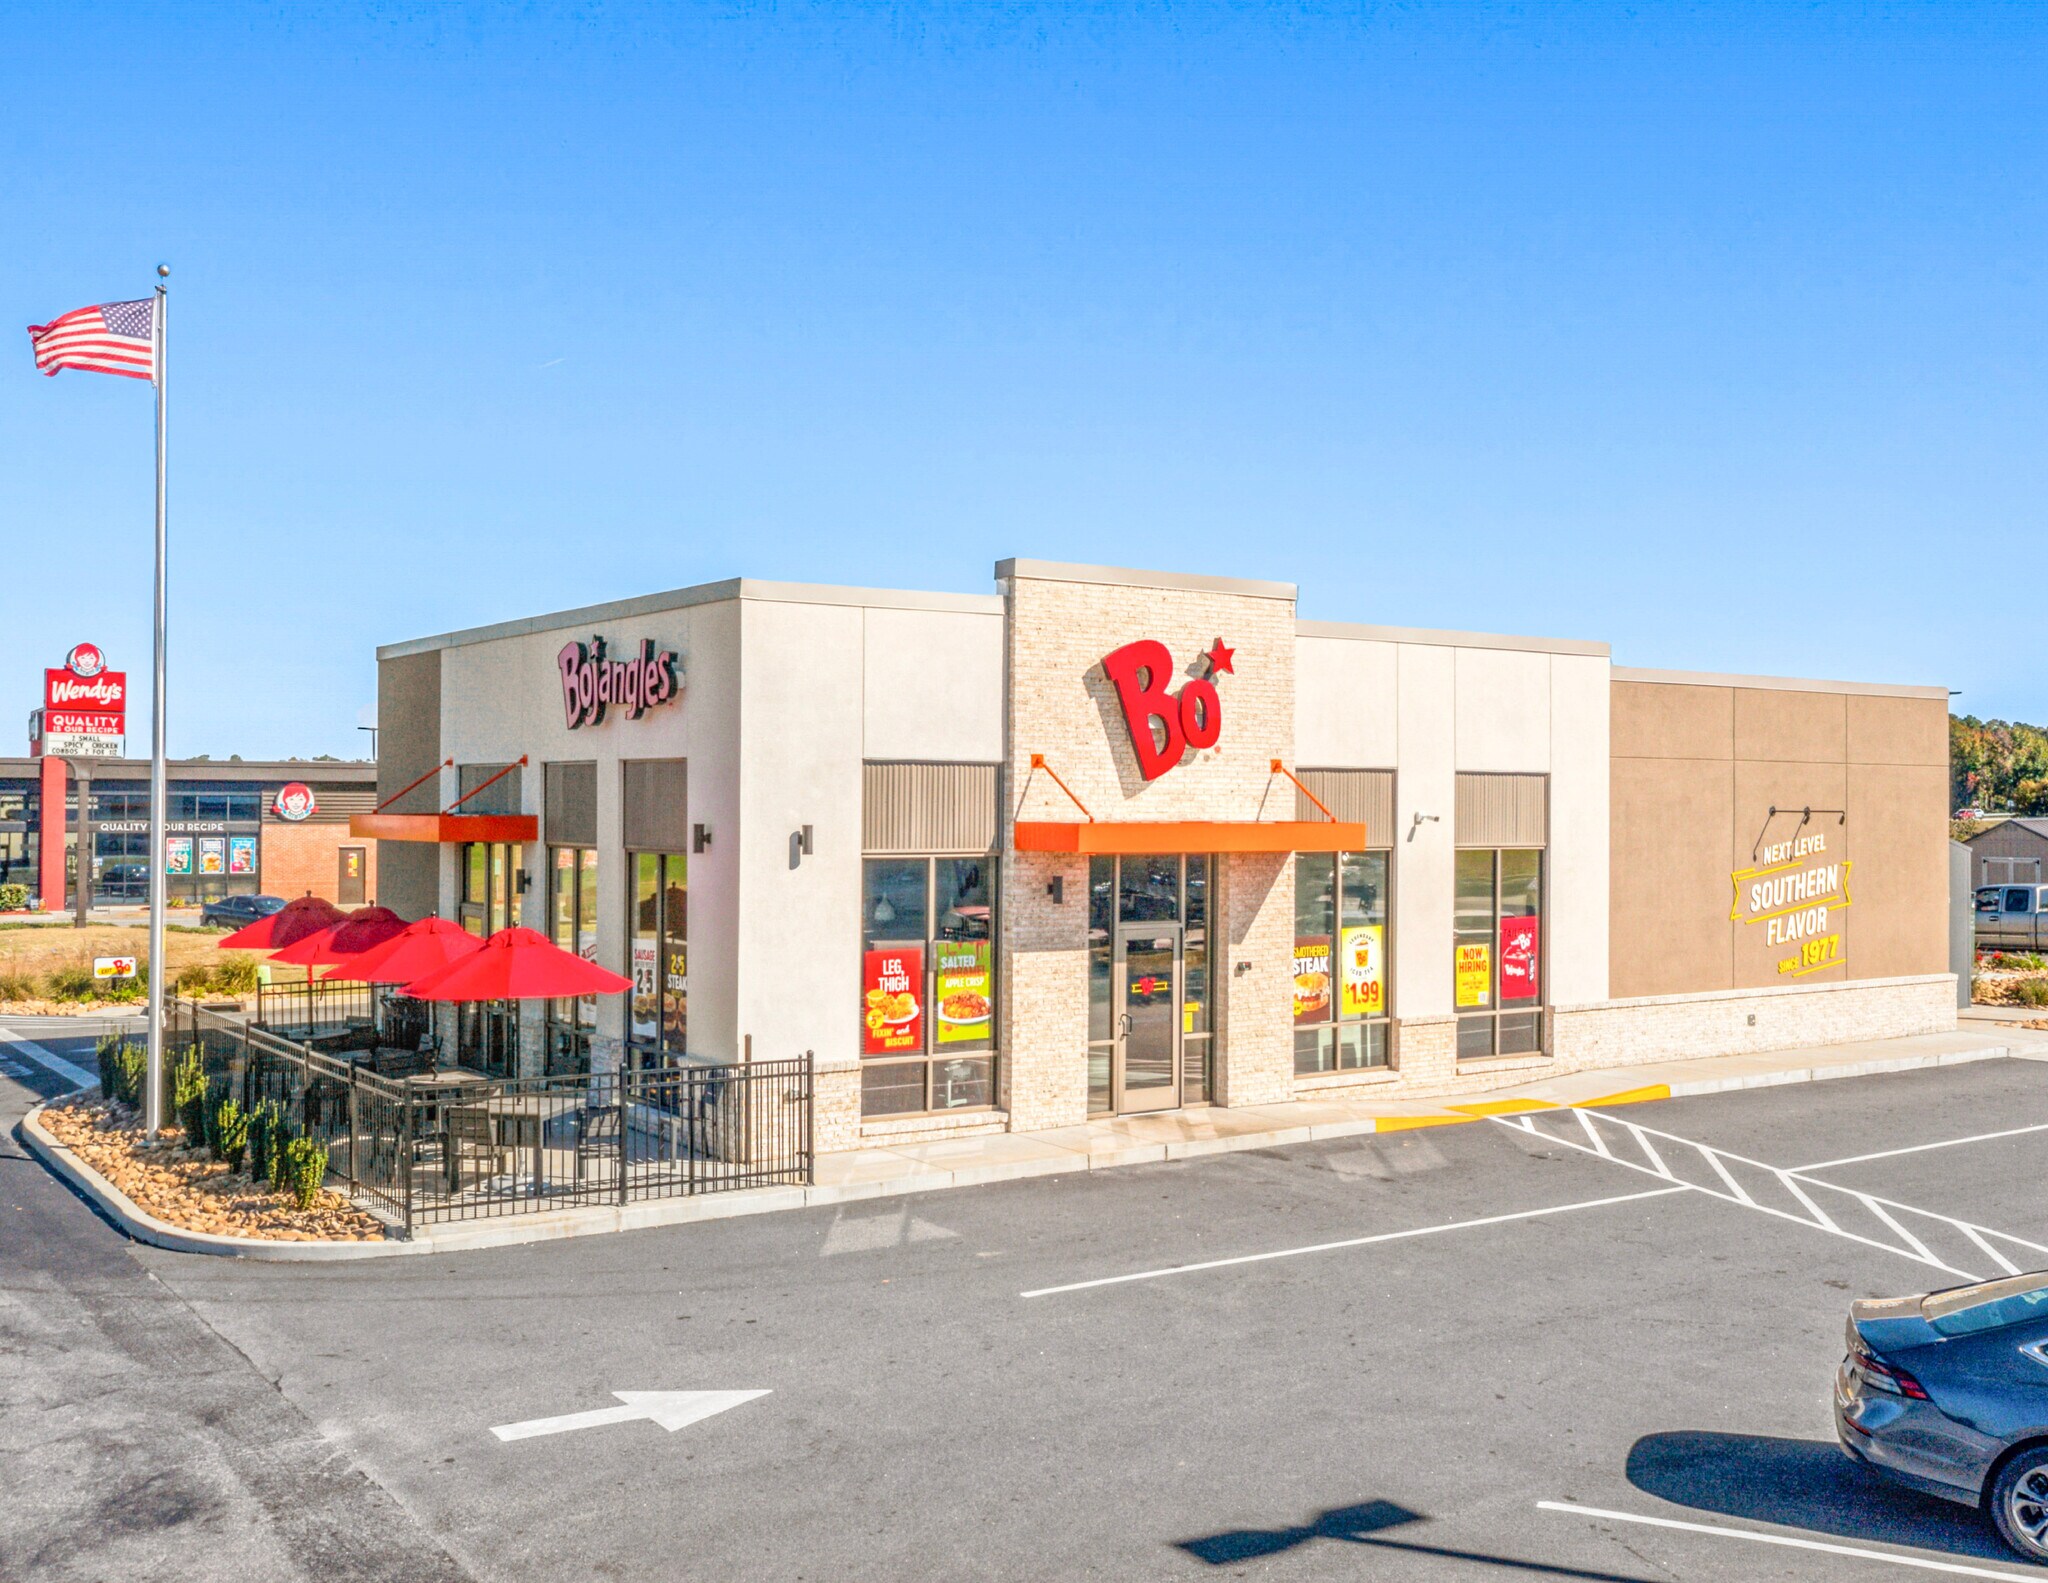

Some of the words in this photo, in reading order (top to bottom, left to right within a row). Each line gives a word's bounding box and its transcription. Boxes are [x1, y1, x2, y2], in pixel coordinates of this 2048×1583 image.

[52, 678, 122, 705] Wendy's
[53, 715, 119, 727] QUALITY
[100, 823, 147, 831] QUALITY
[187, 823, 224, 831] RECIPE
[1763, 842, 1793, 866] NEXT
[1794, 834, 1826, 858] LEVEL
[1750, 865, 1838, 912] SOUTHERN
[1766, 907, 1828, 947] FLAVOR
[634, 949, 655, 962] SAUSAGE
[1293, 945, 1329, 958] SMOTHERED
[1463, 948, 1483, 960] NOW
[1778, 957, 1800, 974] SINCE
[1801, 934, 1839, 967] 1977
[882, 959, 905, 976] LEG,
[941, 955, 976, 969] SALTED
[1293, 956, 1329, 975] STEAK
[1459, 960, 1487, 974] HIRING
[878, 976, 909, 992] THIGH
[946, 978, 964, 988] APPLE
[965, 976, 985, 987] CRISP
[896, 1024, 910, 1035] and
[885, 1036, 914, 1047] BISCUIT
